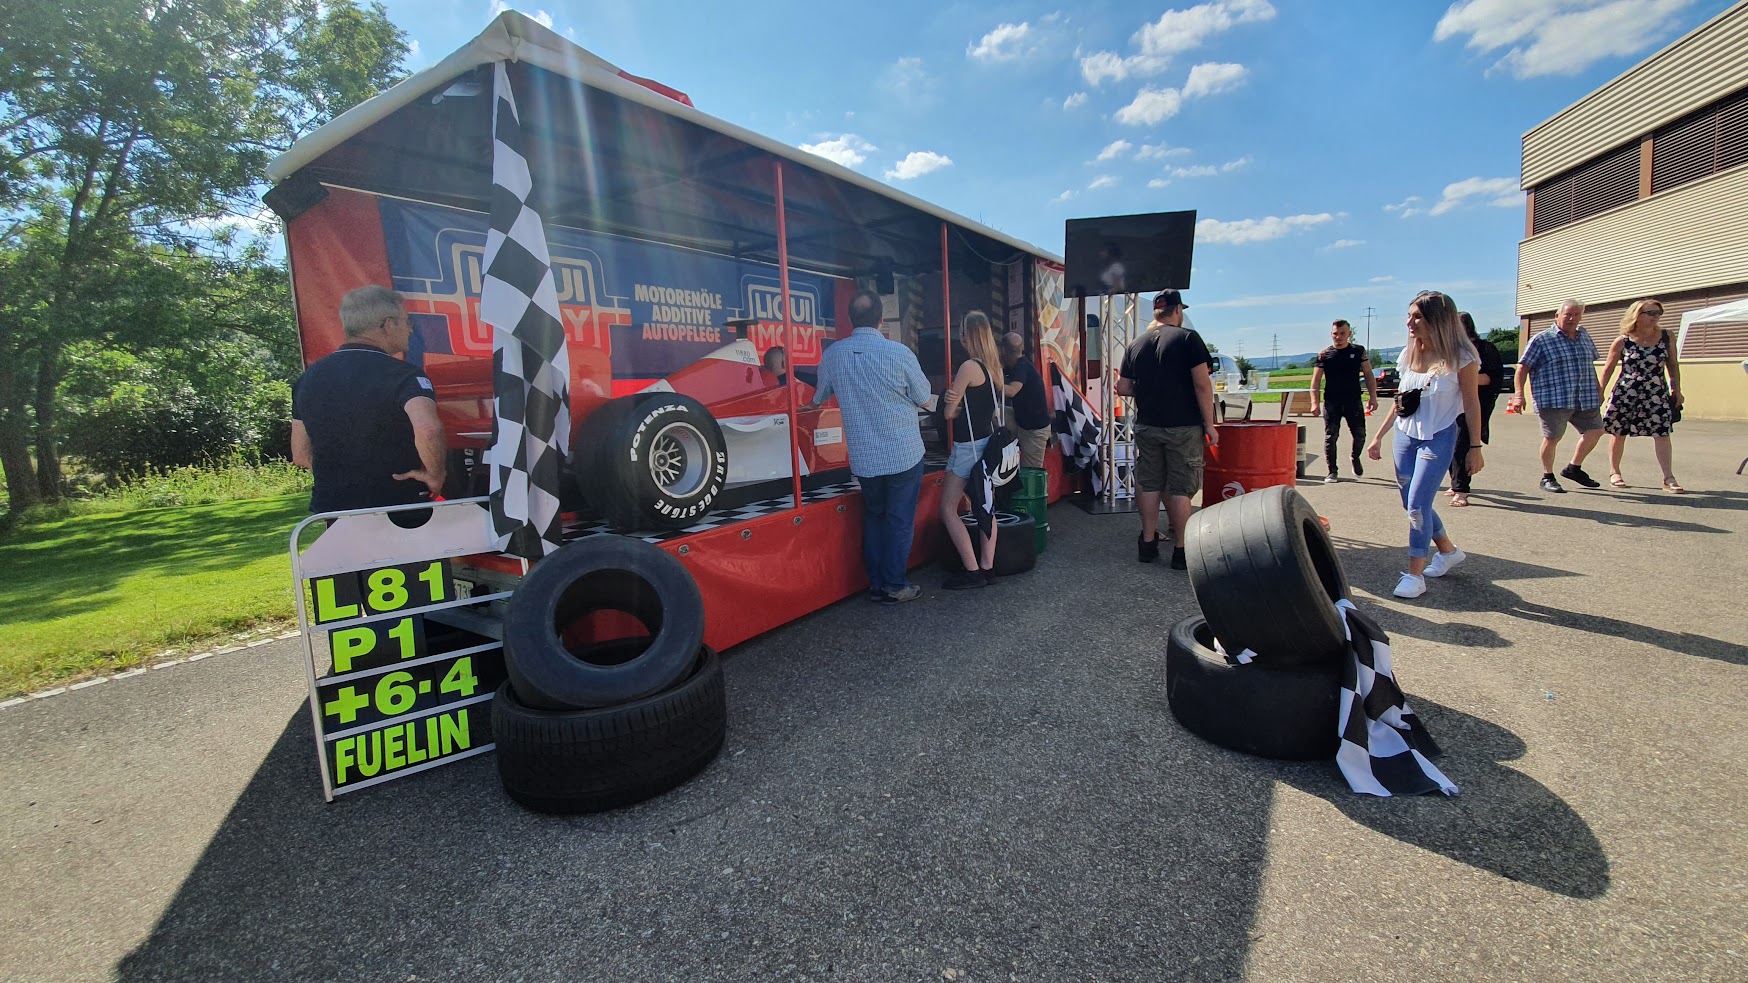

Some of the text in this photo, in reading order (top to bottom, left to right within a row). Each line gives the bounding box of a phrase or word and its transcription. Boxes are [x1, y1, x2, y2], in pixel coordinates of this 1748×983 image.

[635, 284, 723, 310] MOTORENÖLE
[652, 304, 712, 326] ADDITIVE
[642, 322, 721, 343] AUTOPFLEGE
[629, 404, 689, 462] POTENZA
[653, 451, 725, 519] BRIDGESTONE
[316, 562, 445, 622] L81
[332, 617, 416, 674] P1
[335, 708, 471, 785] FUELIN
